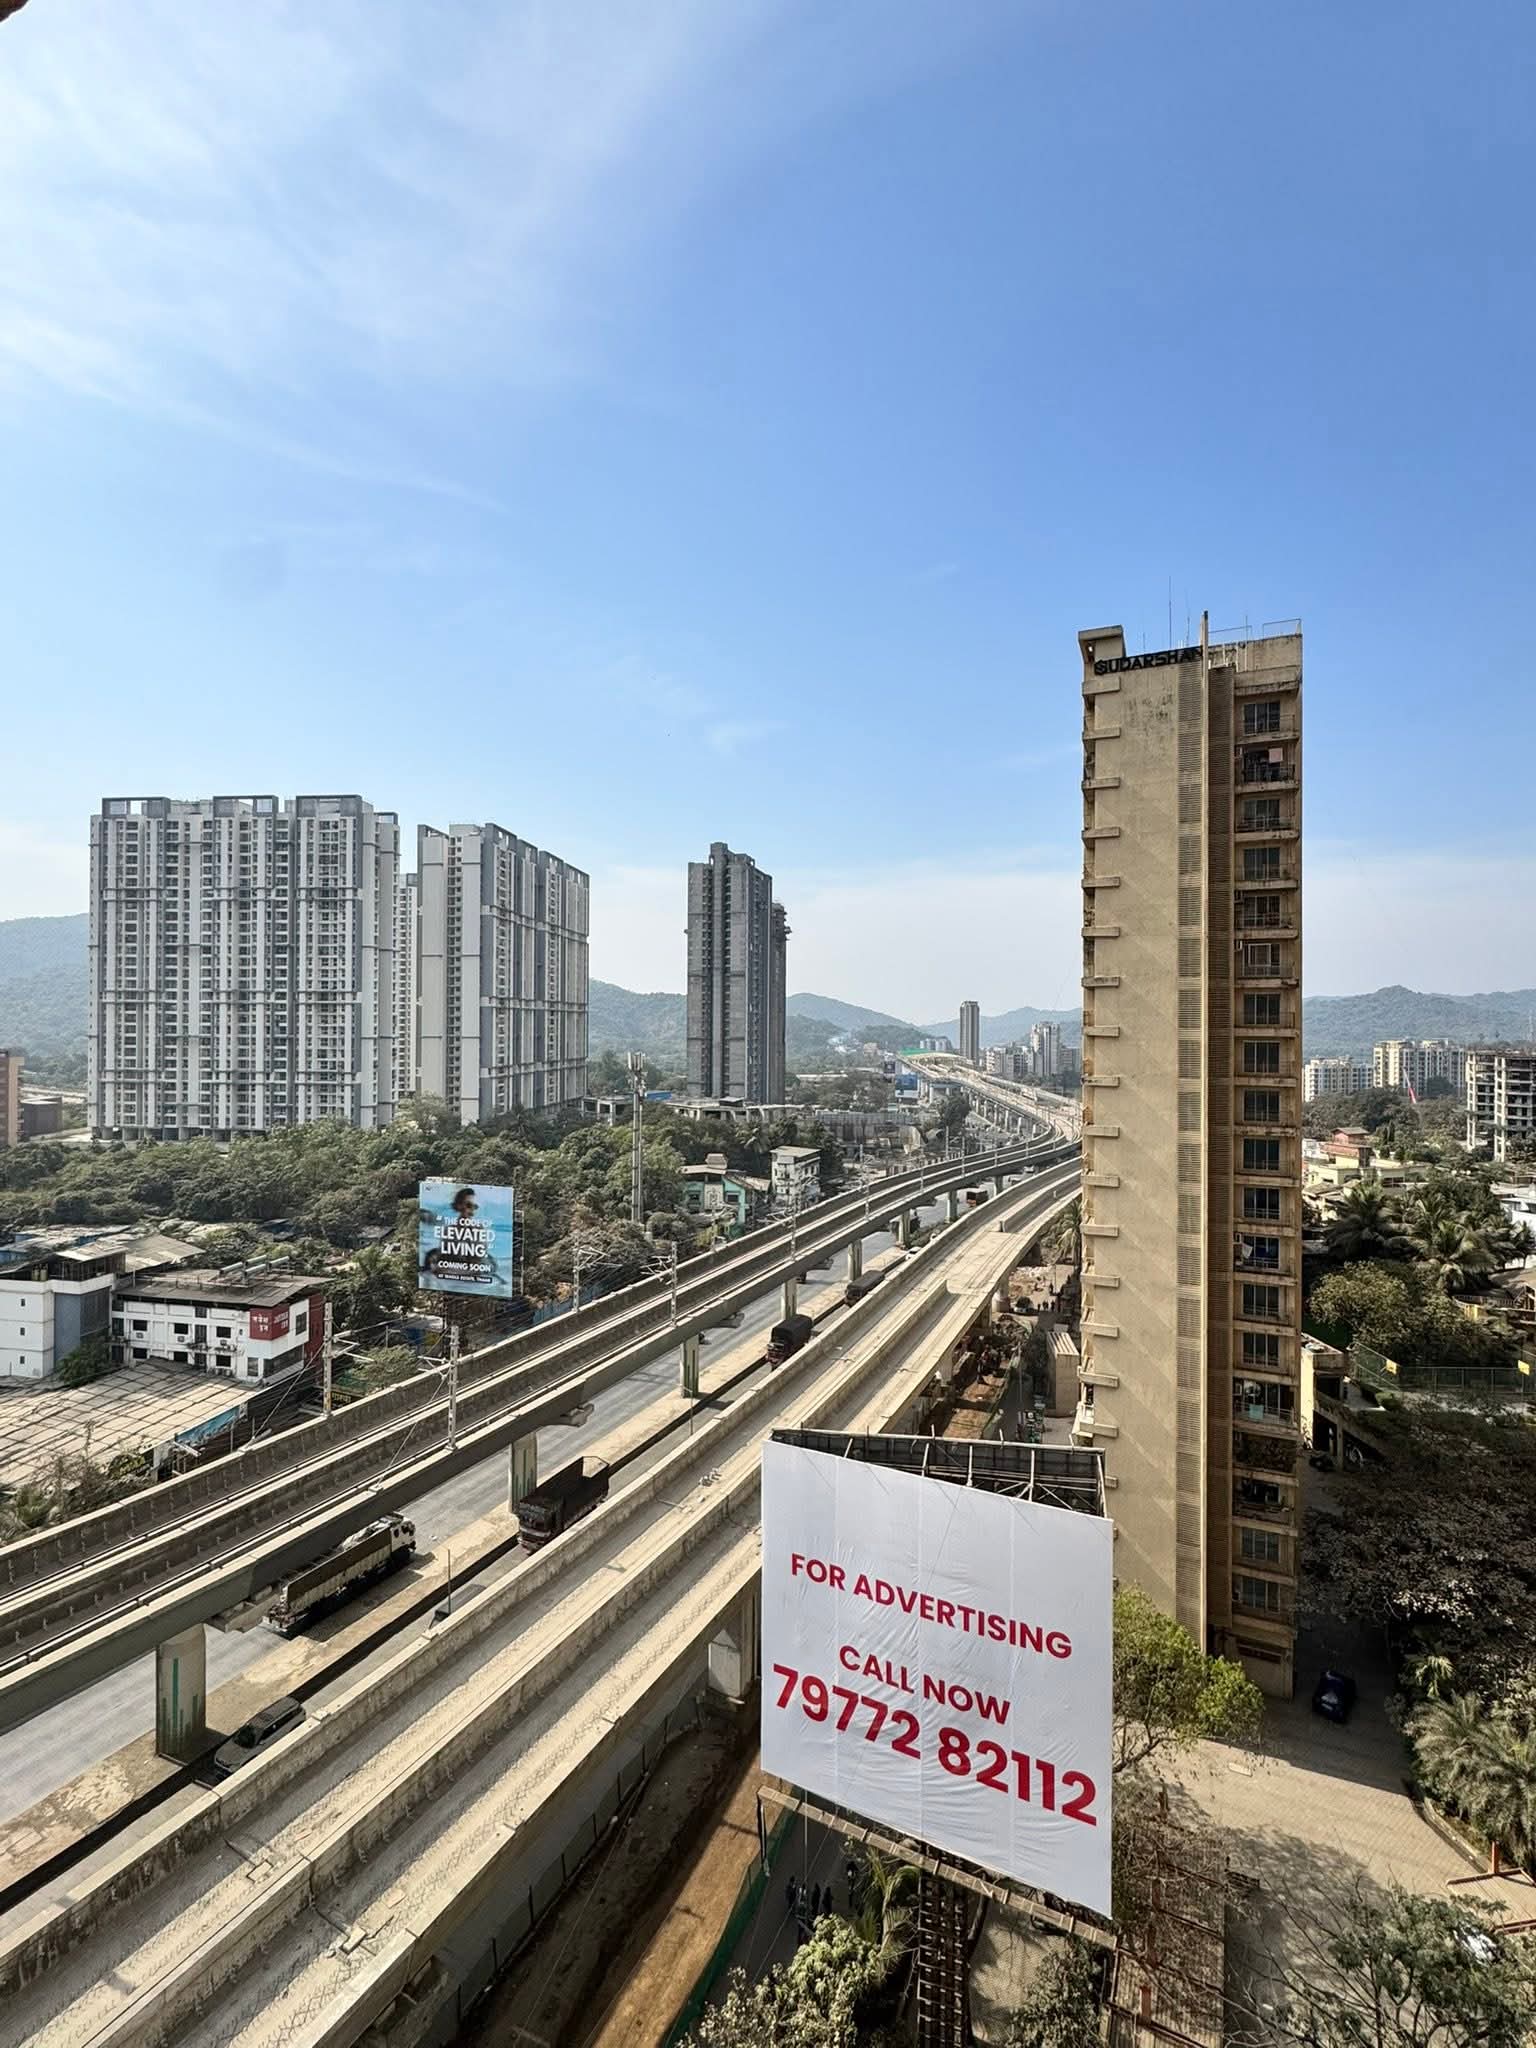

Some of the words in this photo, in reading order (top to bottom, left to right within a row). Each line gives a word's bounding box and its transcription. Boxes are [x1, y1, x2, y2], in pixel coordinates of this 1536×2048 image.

[433, 1225, 496, 1243] ELEVATED
[444, 1216, 458, 1226] THE
[459, 1217, 480, 1227] CODE
[438, 1260, 468, 1270] COMING
[469, 1263, 491, 1273] SOON
[790, 1553, 846, 1591] FOR
[853, 1574, 1073, 1660] ADVERTISING
[838, 1646, 915, 1694] CALL
[922, 1675, 1011, 1726] NOW
[772, 1664, 922, 1760] 79772
[937, 1727, 1098, 1827] 82112
